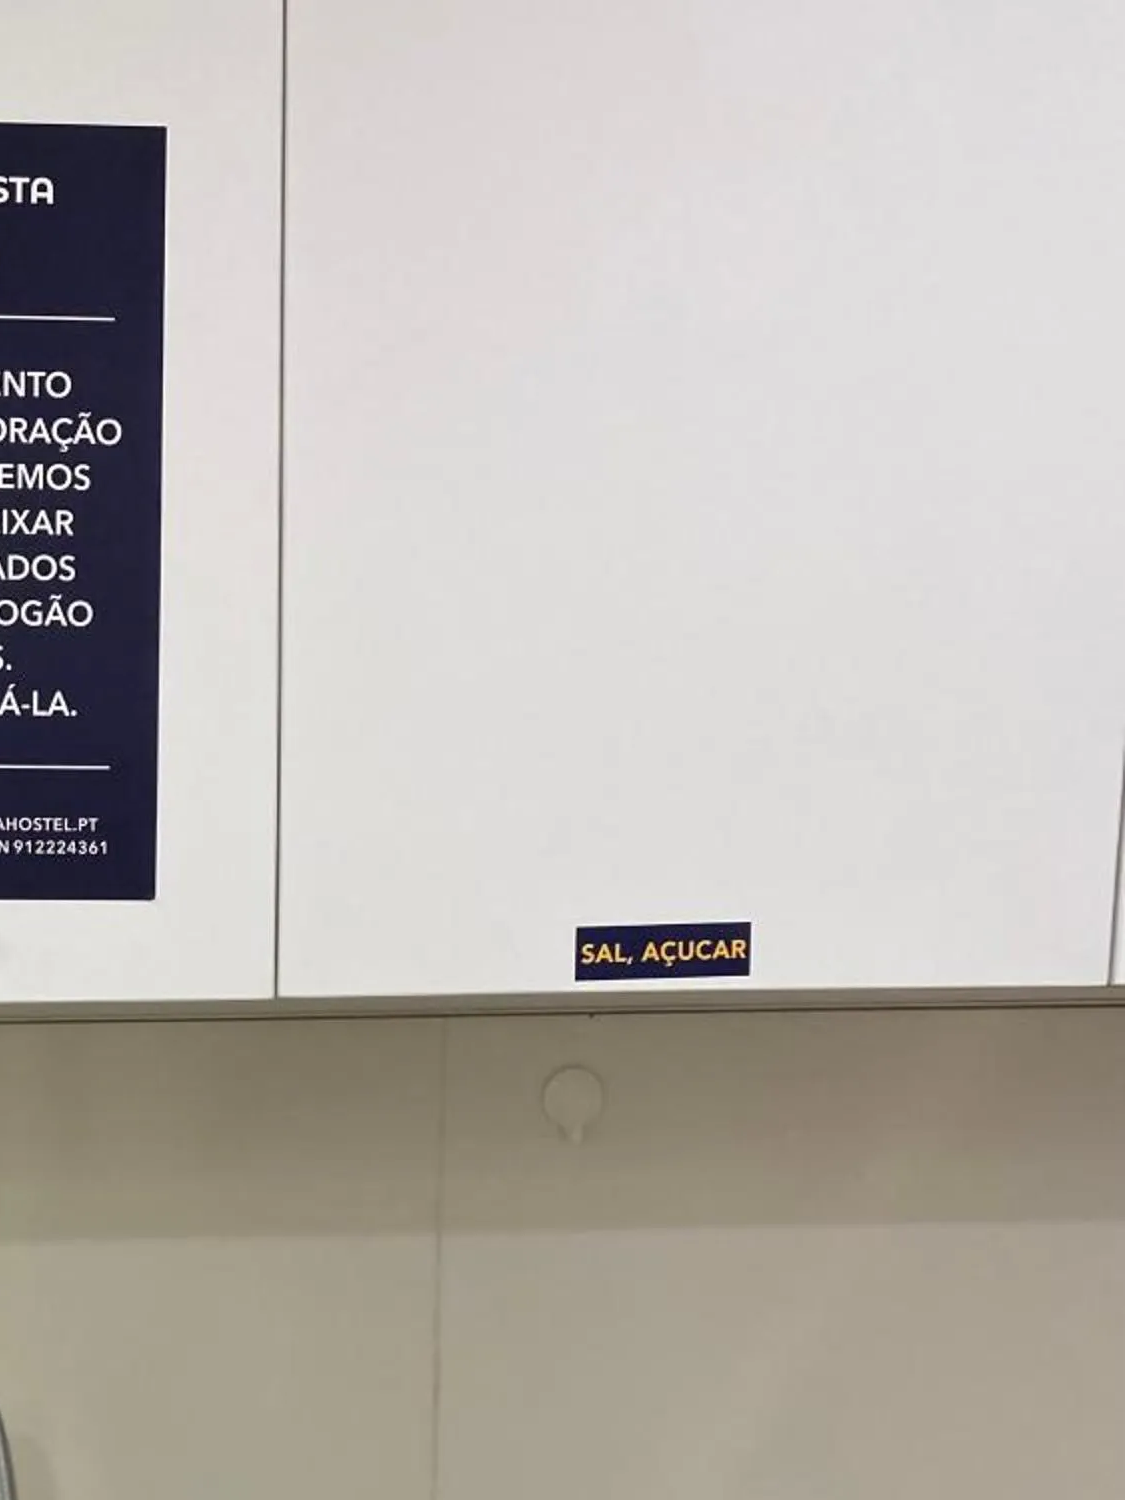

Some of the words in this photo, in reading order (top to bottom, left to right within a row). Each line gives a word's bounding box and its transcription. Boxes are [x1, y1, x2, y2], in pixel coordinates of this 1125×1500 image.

[12, 840, 107, 855] 912224361
[581, 943, 633, 965] SAL,
[641, 939, 747, 967] AÇUCAR
